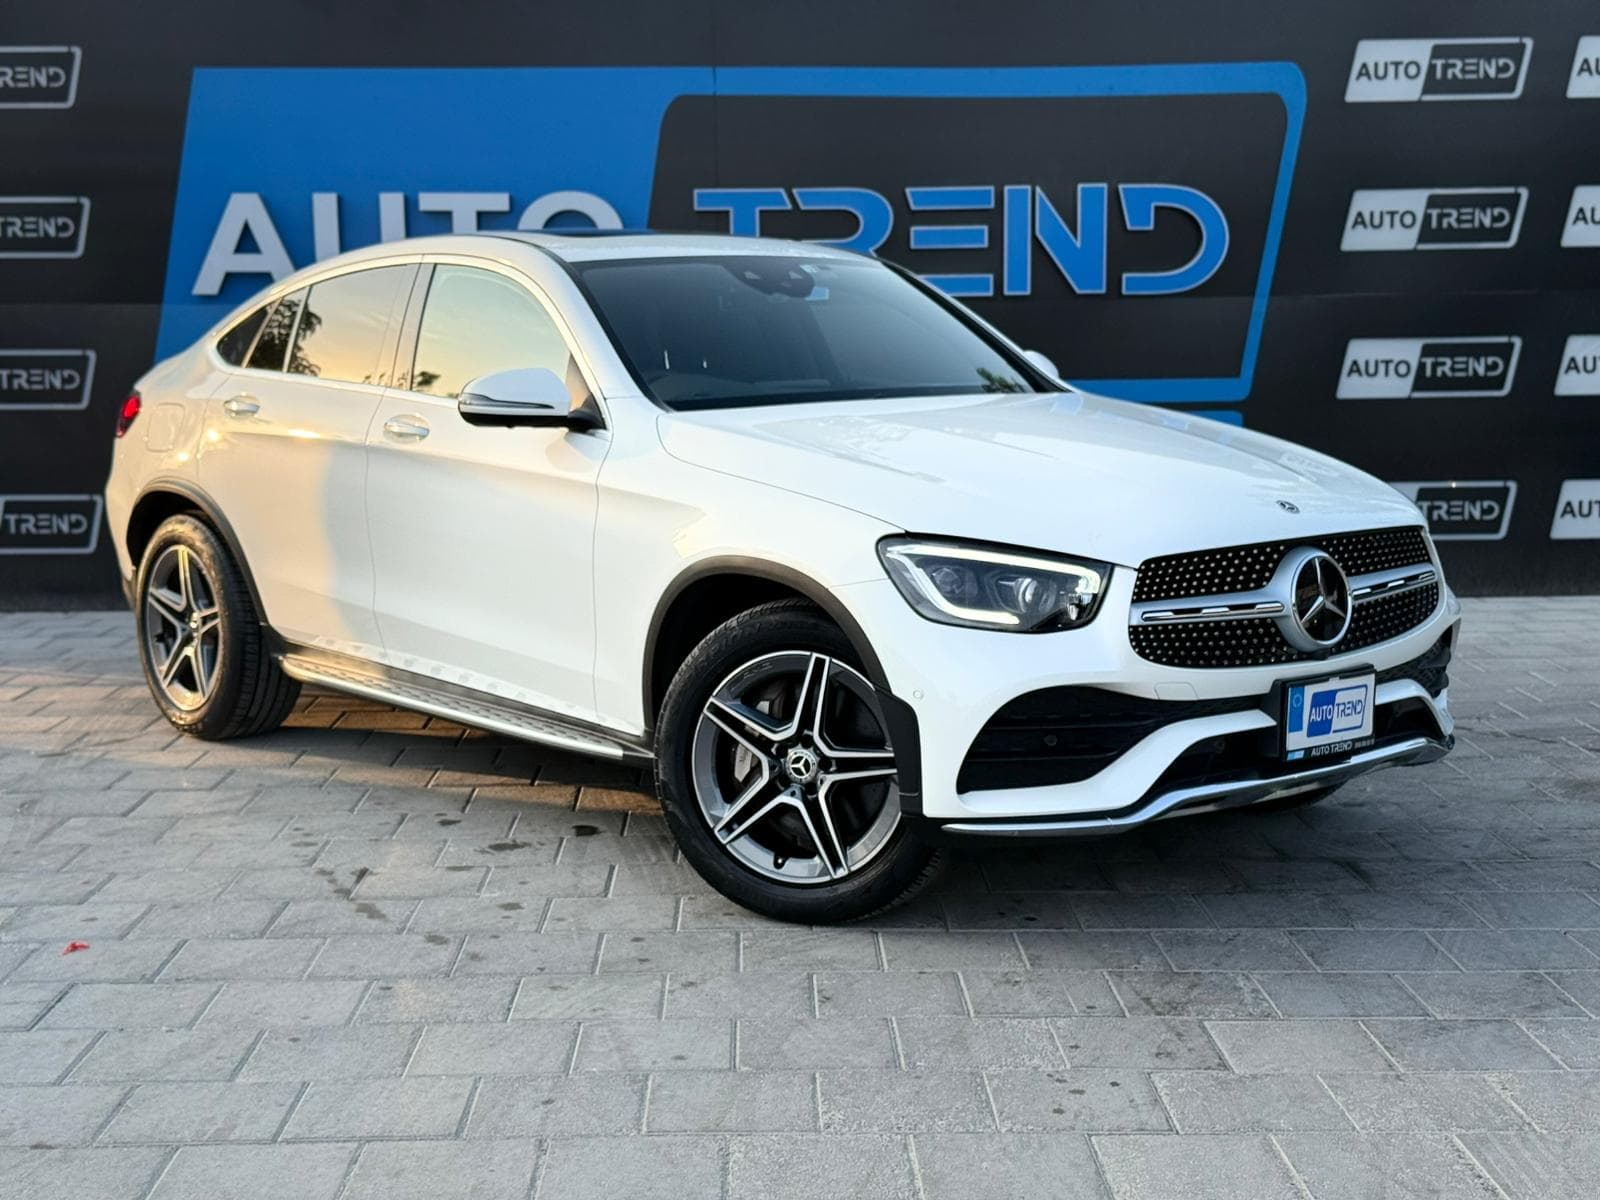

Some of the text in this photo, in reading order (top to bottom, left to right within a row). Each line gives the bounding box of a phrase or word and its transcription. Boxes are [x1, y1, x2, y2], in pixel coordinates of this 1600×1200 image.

[1355, 57, 1515, 81] AUTO TREND
[1351, 206, 1511, 230] AUTO TREND
[693, 183, 1230, 297] TREND
[1346, 356, 1504, 379] AUTO TREND
[1564, 356, 1600, 375] AU
[0, 369, 80, 390] TREND
[1417, 500, 1500, 521] TREND
[4, 513, 88, 535] TREND
[1310, 700, 1363, 722] AUTO TREND
[1311, 745, 1330, 757] AUTO
[1330, 741, 1353, 754] TREND
